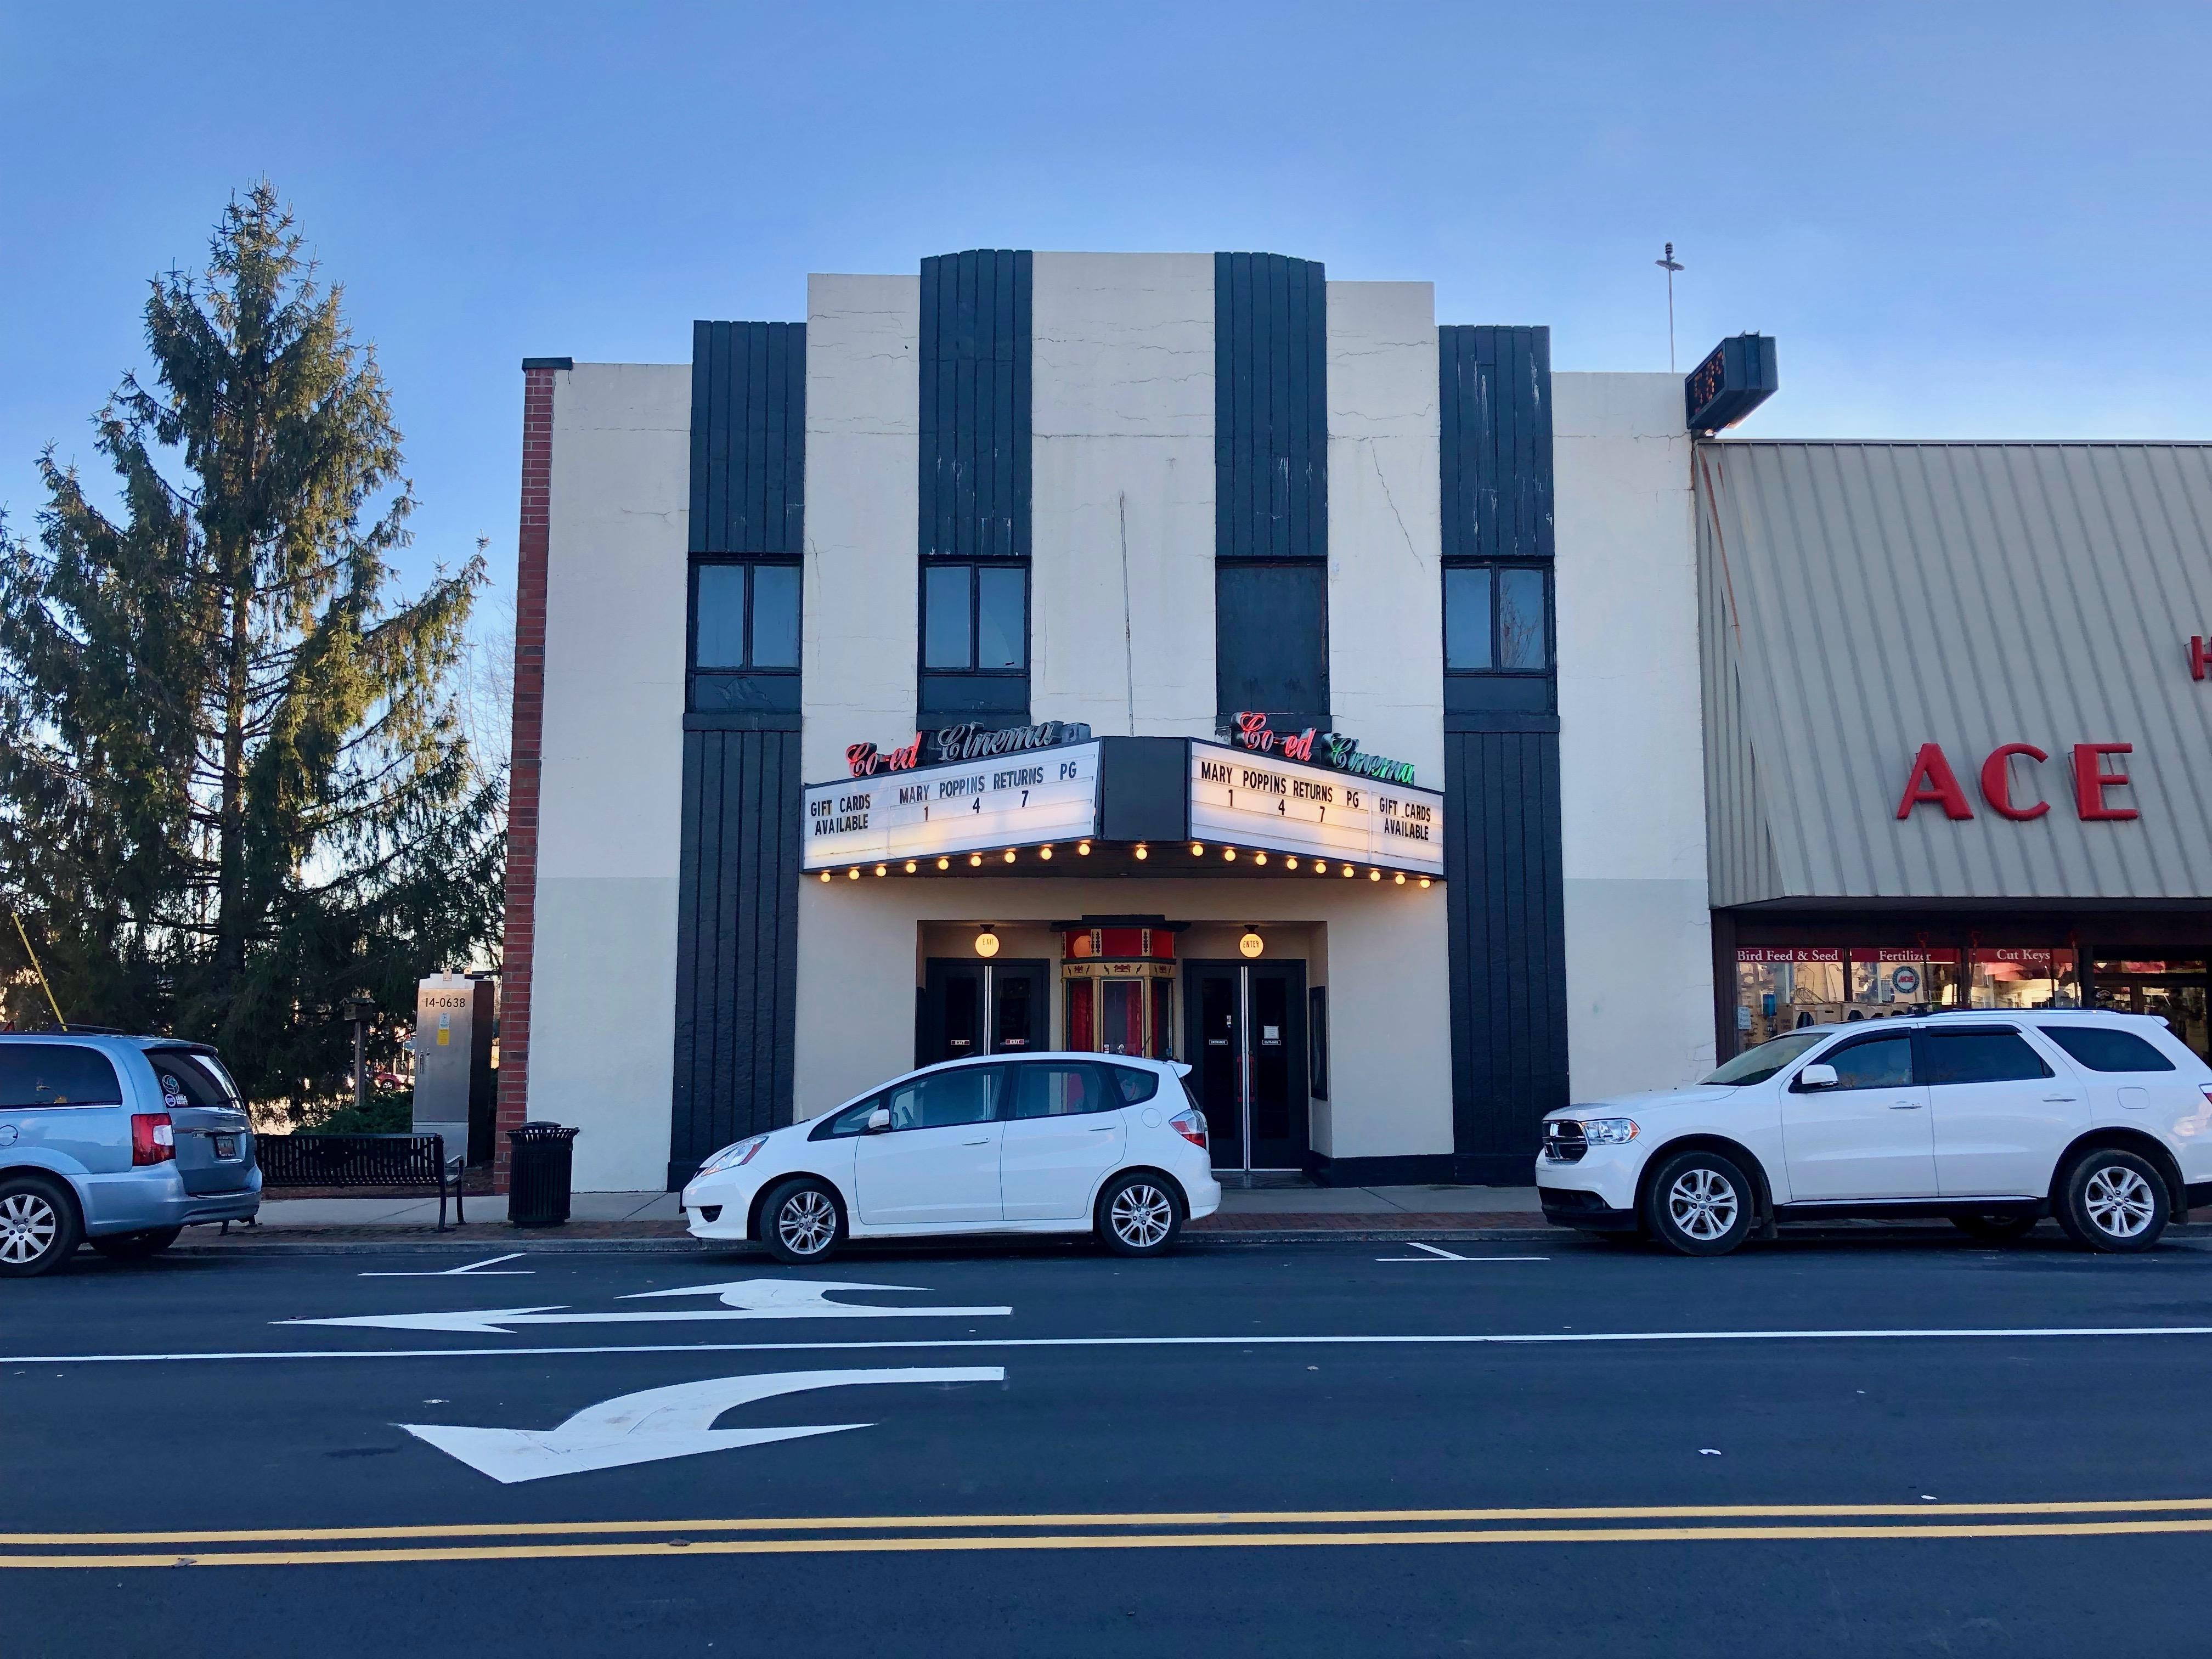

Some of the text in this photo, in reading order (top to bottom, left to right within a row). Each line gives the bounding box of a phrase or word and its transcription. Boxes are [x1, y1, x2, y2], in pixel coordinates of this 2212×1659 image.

[845, 721, 1056, 777] Co-ed Cinema
[1238, 711, 1415, 783] Co-ed Cinema
[900, 761, 1076, 804] MARY POPPINS RETURNS PG
[1201, 761, 1359, 808] MARY POPPINS RETURNS PG
[1897, 743, 2138, 821] ACE
[811, 794, 871, 816] GIFT CARDS
[923, 791, 1029, 821] 1 4 7
[1228, 789, 1325, 822] 1 4 7
[1380, 797, 1431, 822] GIFT CARDS
[815, 814, 868, 836] AVAILABLE
[1384, 819, 1429, 841] AVAILABLE
[1737, 950, 1838, 961] Bird Feed & Seed
[1996, 949, 2051, 963] Cut Keys
[1898, 975, 1914, 984] ACE
[425, 997, 465, 1008] 14-0638
